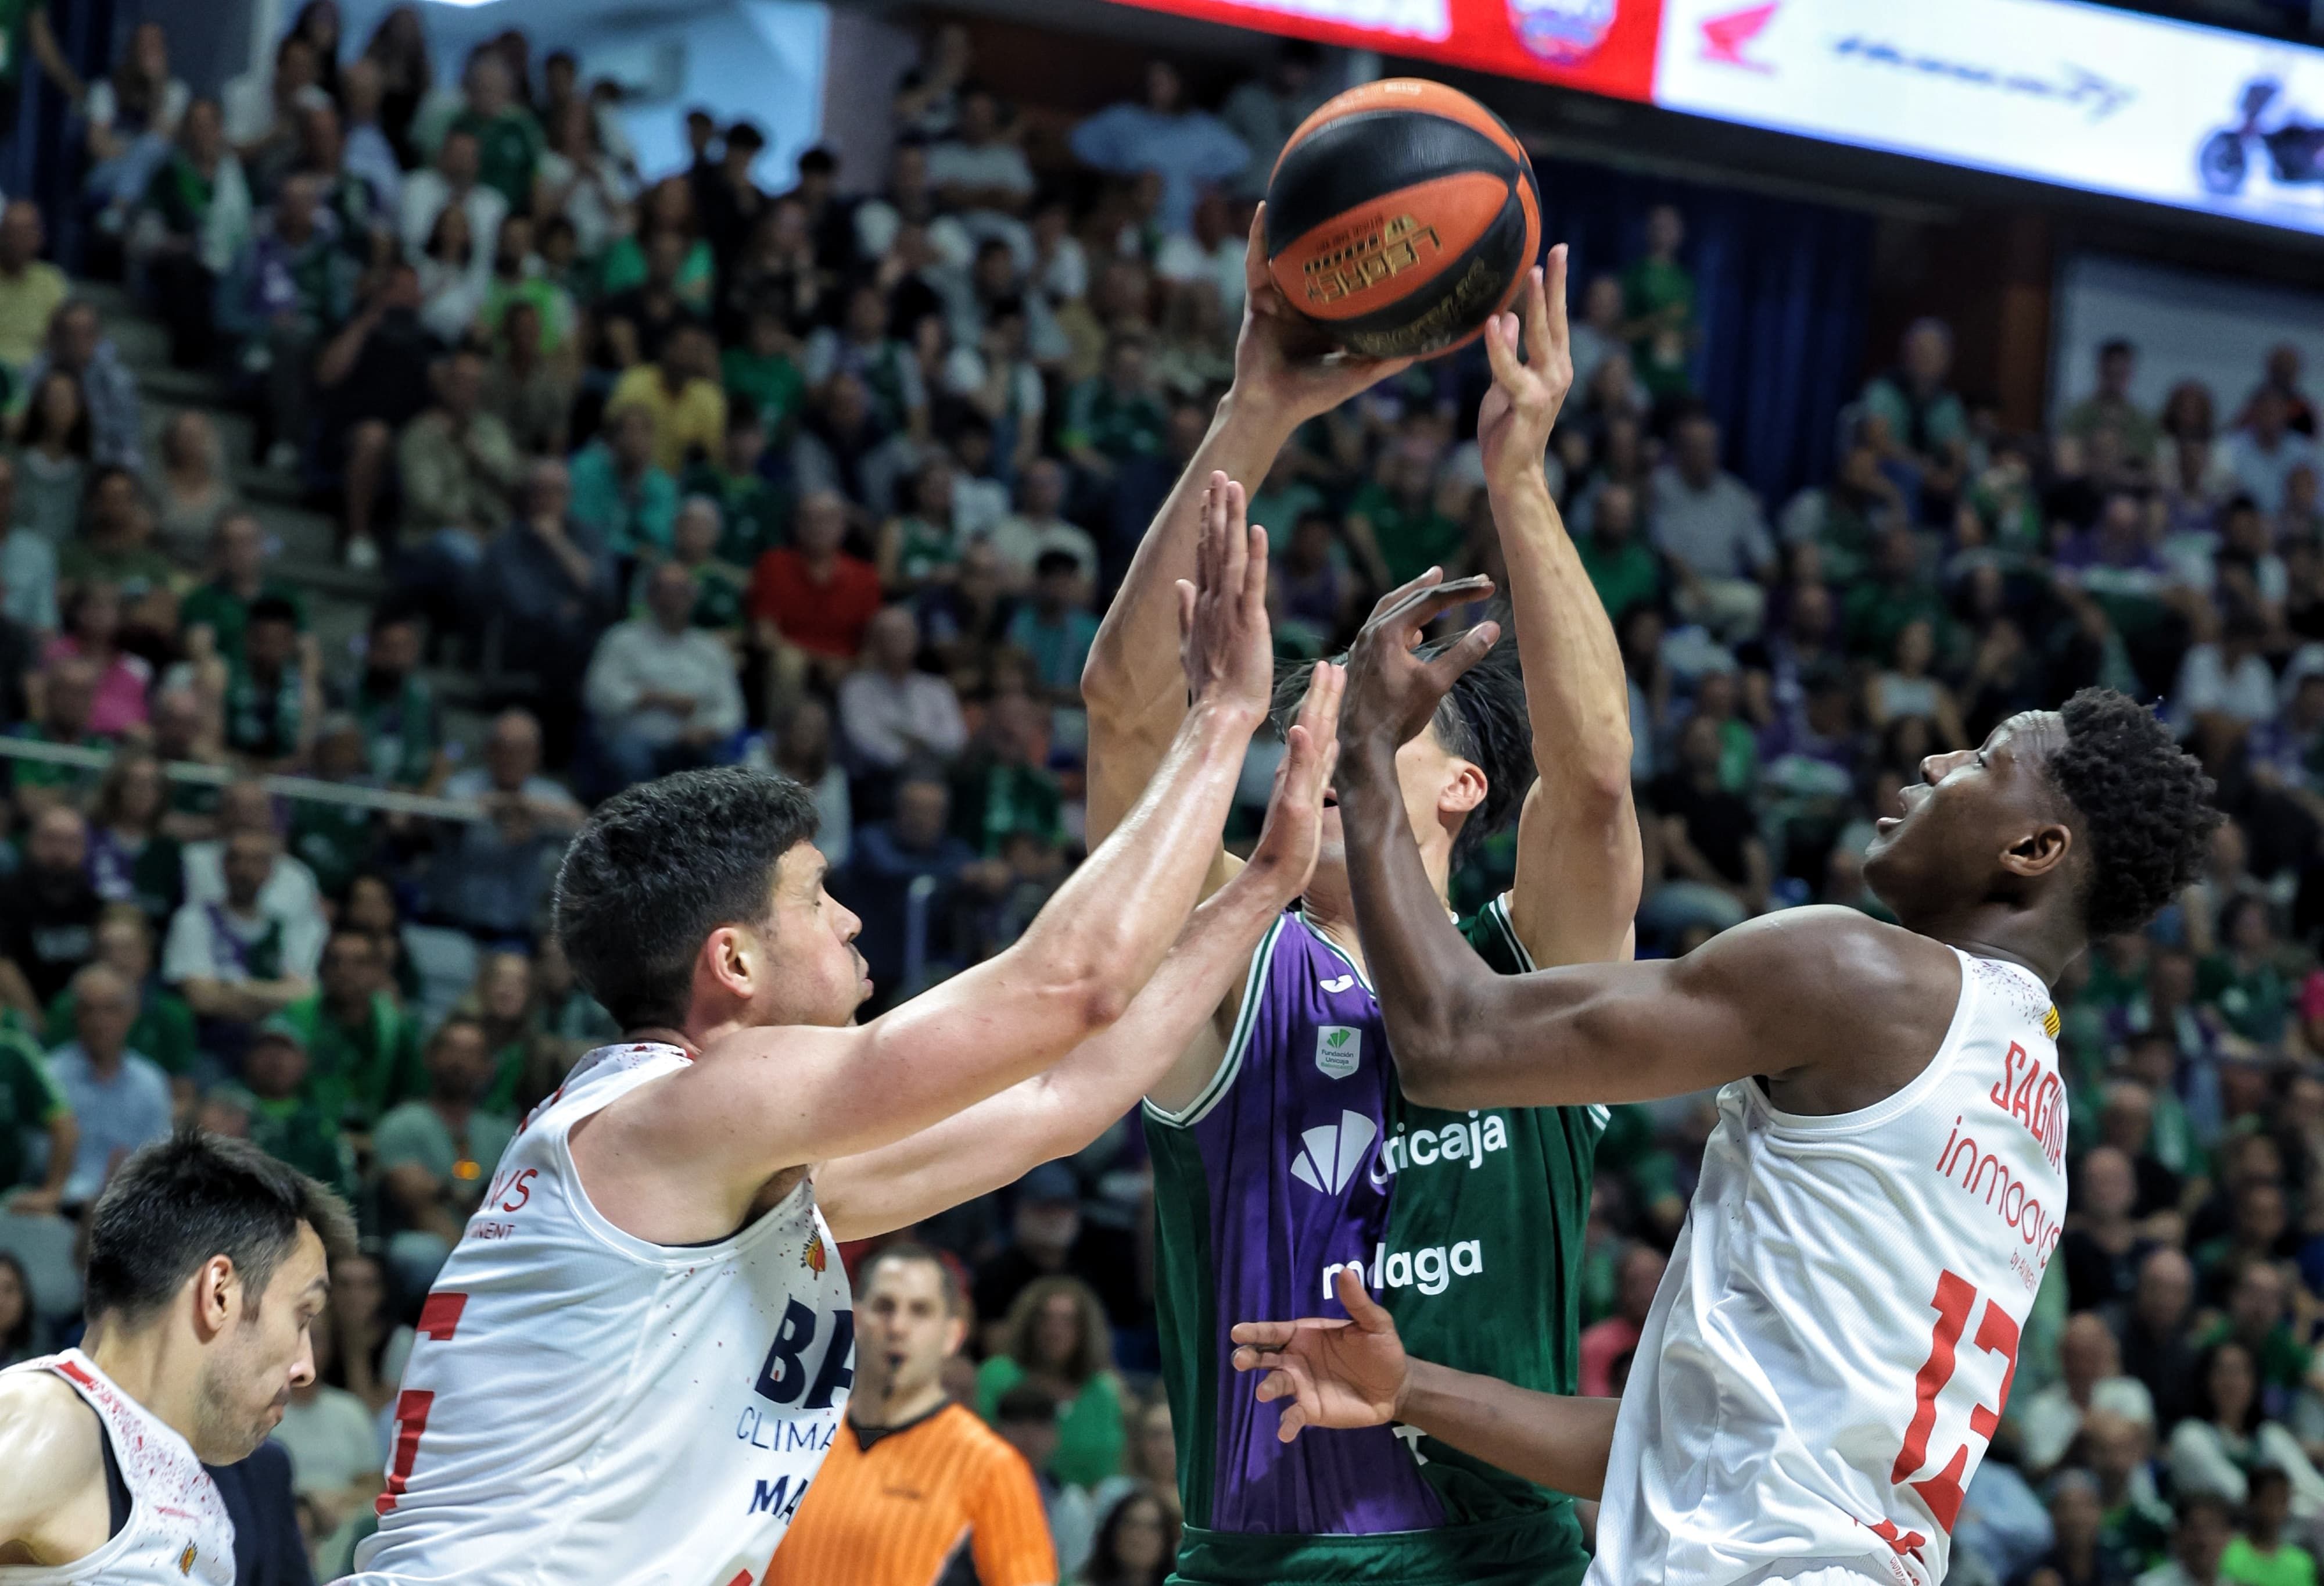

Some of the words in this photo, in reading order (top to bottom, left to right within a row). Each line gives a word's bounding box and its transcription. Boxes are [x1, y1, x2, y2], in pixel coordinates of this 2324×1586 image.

[1321, 1048, 1354, 1058] Fundación
[1325, 1057, 1350, 1065] Unicaja
[1322, 1239, 1483, 1300] mlaga
